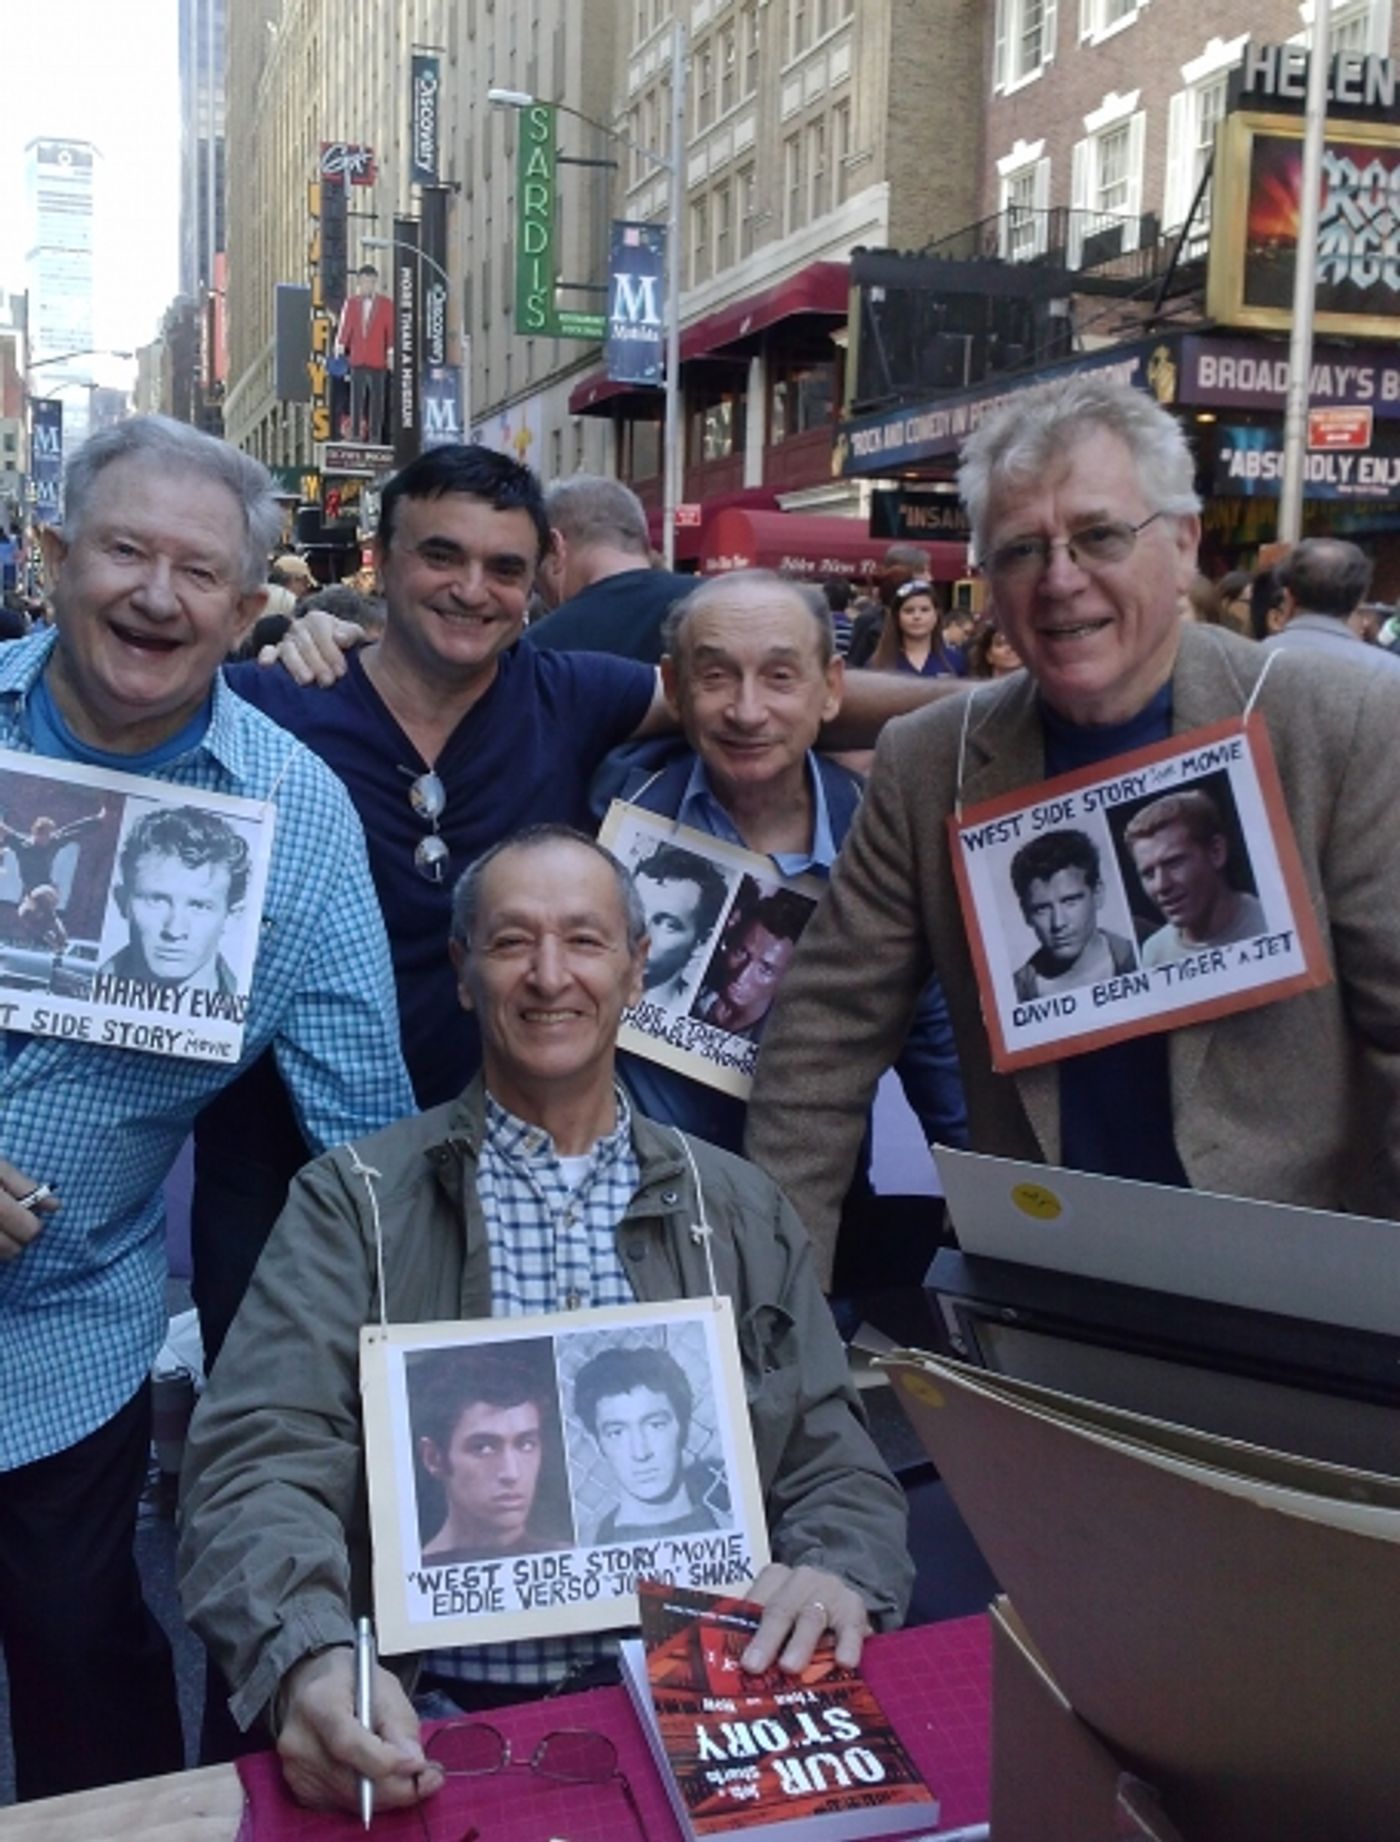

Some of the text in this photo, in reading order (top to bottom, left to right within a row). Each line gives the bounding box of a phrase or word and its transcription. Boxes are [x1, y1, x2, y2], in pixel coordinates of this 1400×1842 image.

[1245, 45, 1394, 105] HEEN
[416, 76, 437, 173] Discovery
[610, 273, 662, 324] M
[401, 310, 413, 352] THAN
[402, 369, 413, 428] MUSEUM
[1219, 448, 1352, 484] "ABSDLY
[960, 814, 1025, 852] WEST
[1031, 801, 1077, 831] SIDE
[1083, 772, 1149, 814] STORY
[1180, 740, 1243, 779] MOVIE
[92, 973, 189, 1015] HARVEY
[1012, 994, 1077, 1028] DAVID
[1092, 972, 1151, 1007] BEAN
[1251, 930, 1294, 963] JET
[31, 1008, 93, 1040] SIDE
[102, 1019, 182, 1052] STORY
[184, 1037, 232, 1058] MOVIE
[432, 1588, 505, 1617] EDDIE
[516, 1571, 600, 1610] VERSO
[688, 1556, 754, 1587] SHARK
[513, 1553, 572, 1585] SIDE
[695, 1707, 862, 1762] STORY
[771, 1746, 887, 1796] OUR
